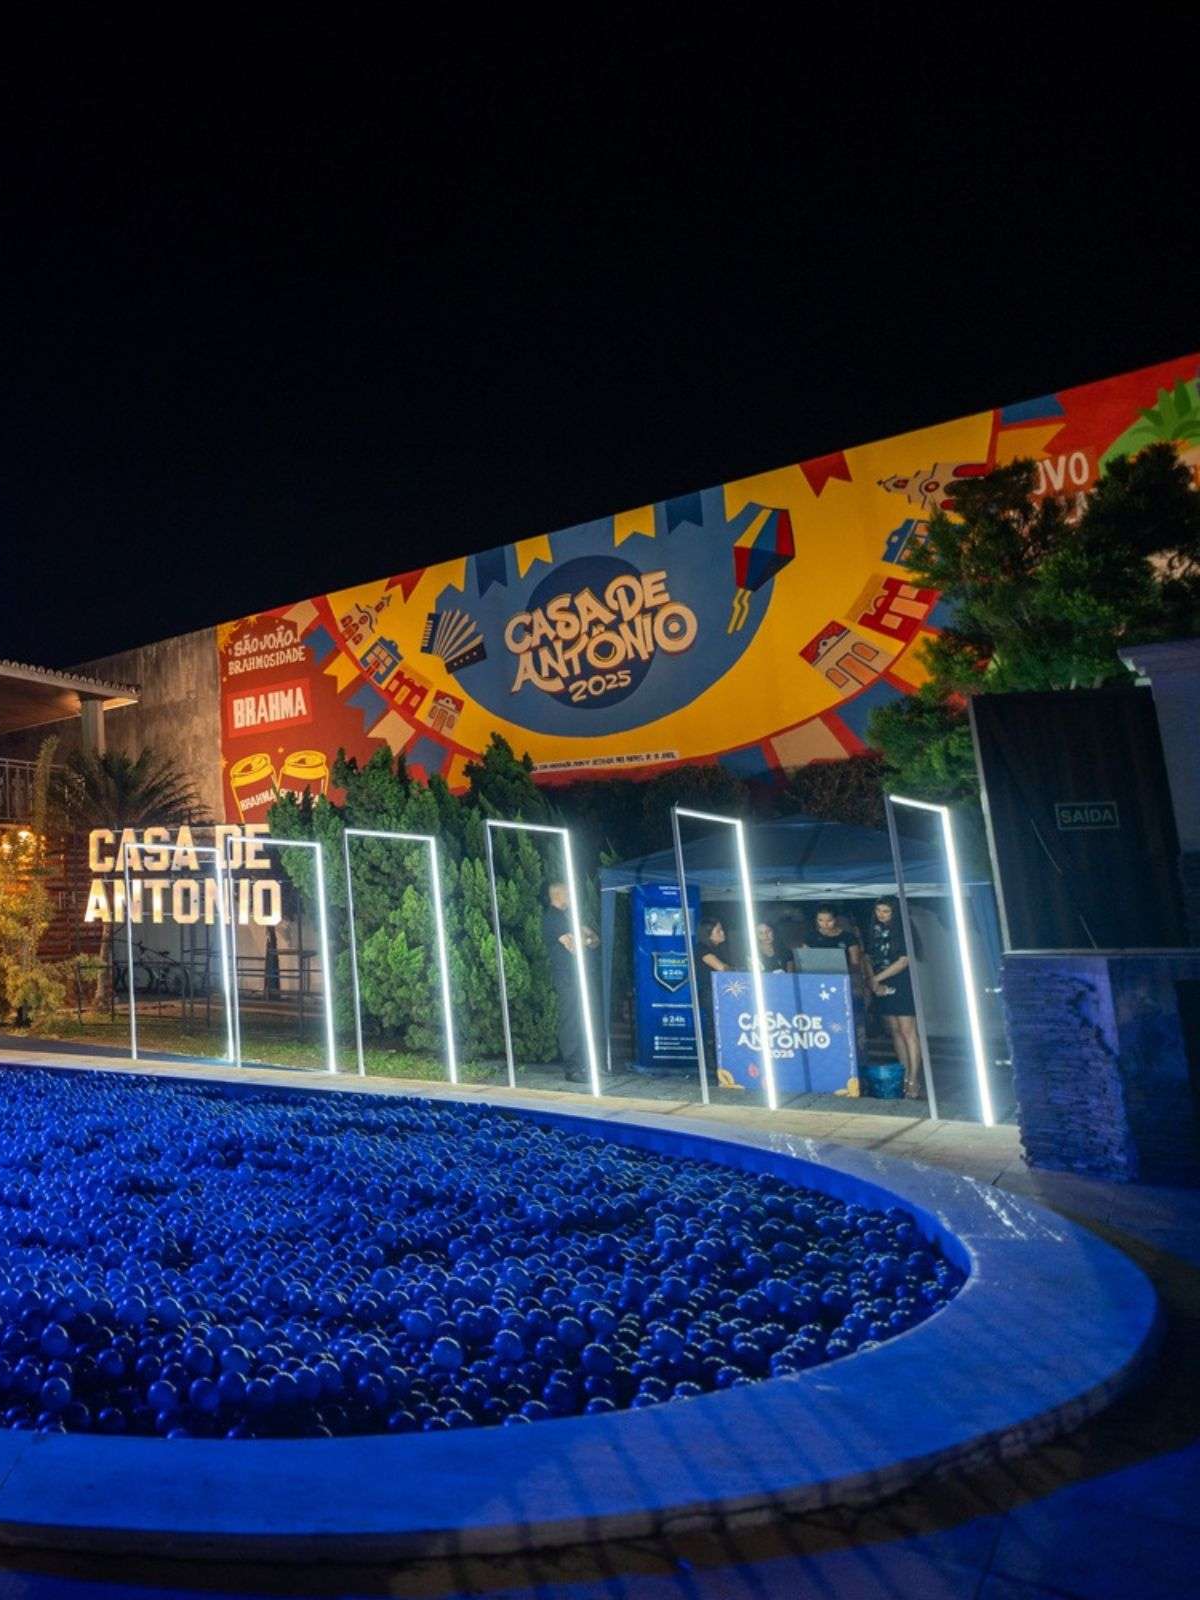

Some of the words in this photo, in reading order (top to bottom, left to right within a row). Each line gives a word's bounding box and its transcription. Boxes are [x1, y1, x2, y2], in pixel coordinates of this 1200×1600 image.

[504, 587, 616, 654] CASA
[604, 570, 671, 623] DE
[228, 646, 307, 675] BRAHMOSIDADE
[233, 633, 259, 657] SÃO
[511, 602, 698, 693] ANTÔNIO
[569, 670, 632, 703] 2025
[232, 687, 308, 729] BRAHMA
[89, 824, 199, 872] CASA
[215, 823, 272, 870] DE
[84, 877, 282, 926] ANTONIO
[738, 1011, 792, 1031] CASA
[792, 1013, 823, 1031] DE
